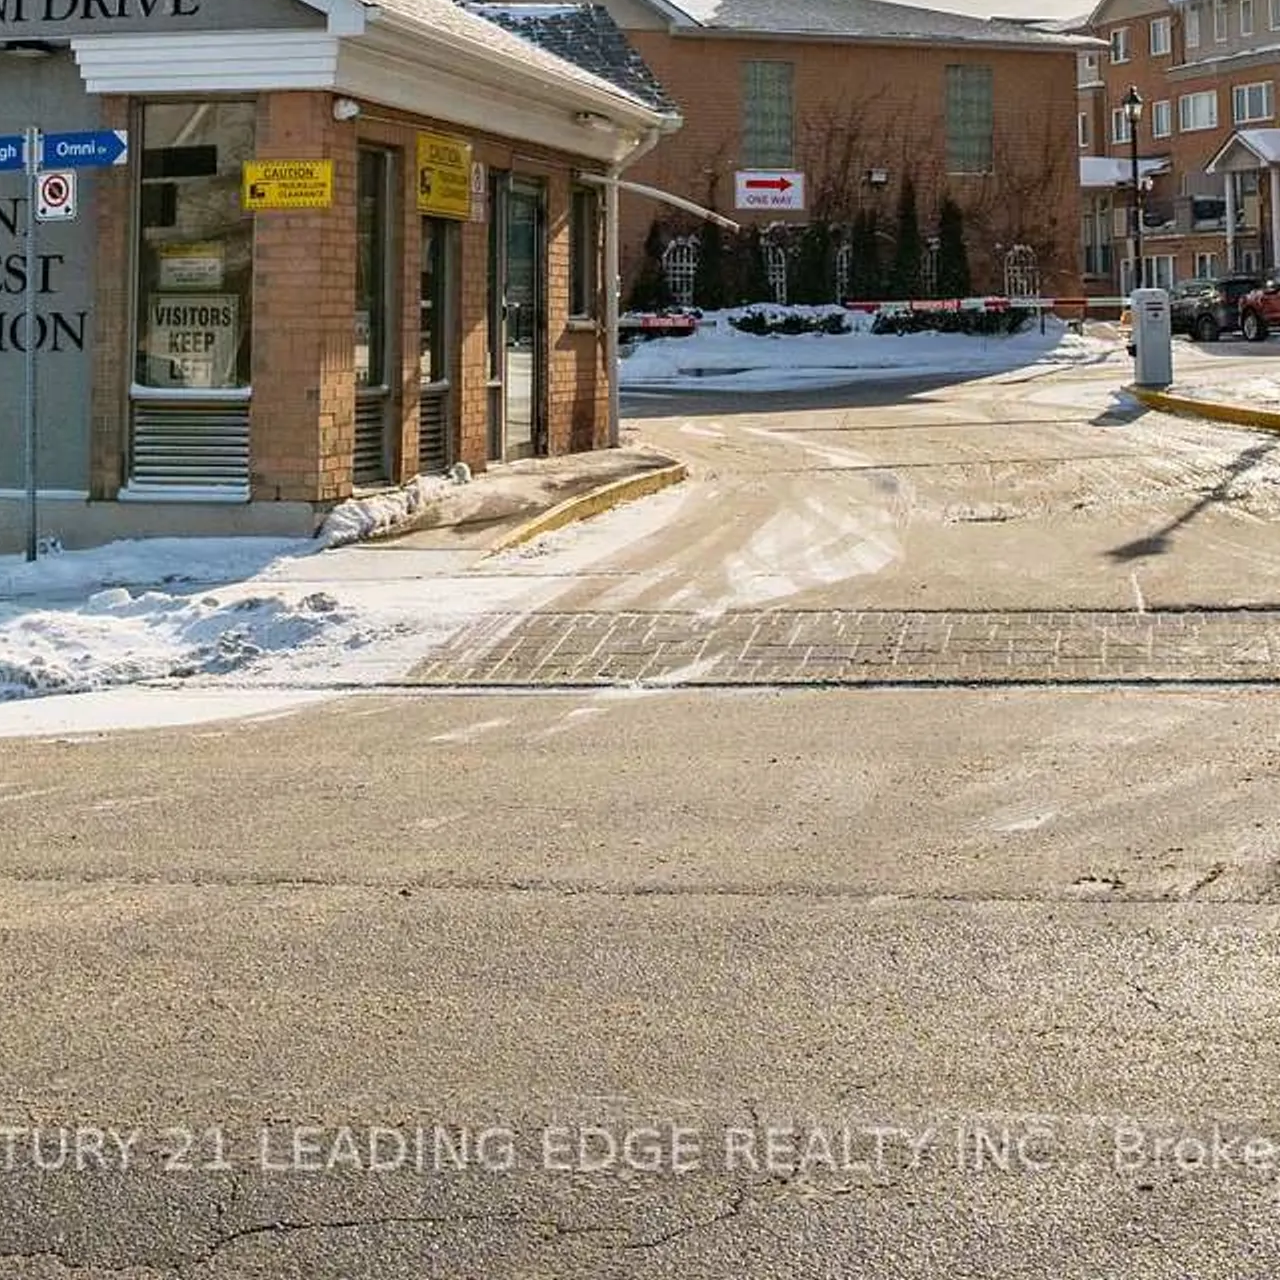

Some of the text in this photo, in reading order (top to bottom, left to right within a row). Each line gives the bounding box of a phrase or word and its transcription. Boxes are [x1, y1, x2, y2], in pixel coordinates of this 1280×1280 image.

[56, 140, 95, 156] Omni
[264, 168, 314, 178] CAUTION
[746, 194, 793, 205] ONE WAY
[156, 306, 231, 327] VISITORS
[169, 331, 215, 353] KEEP
